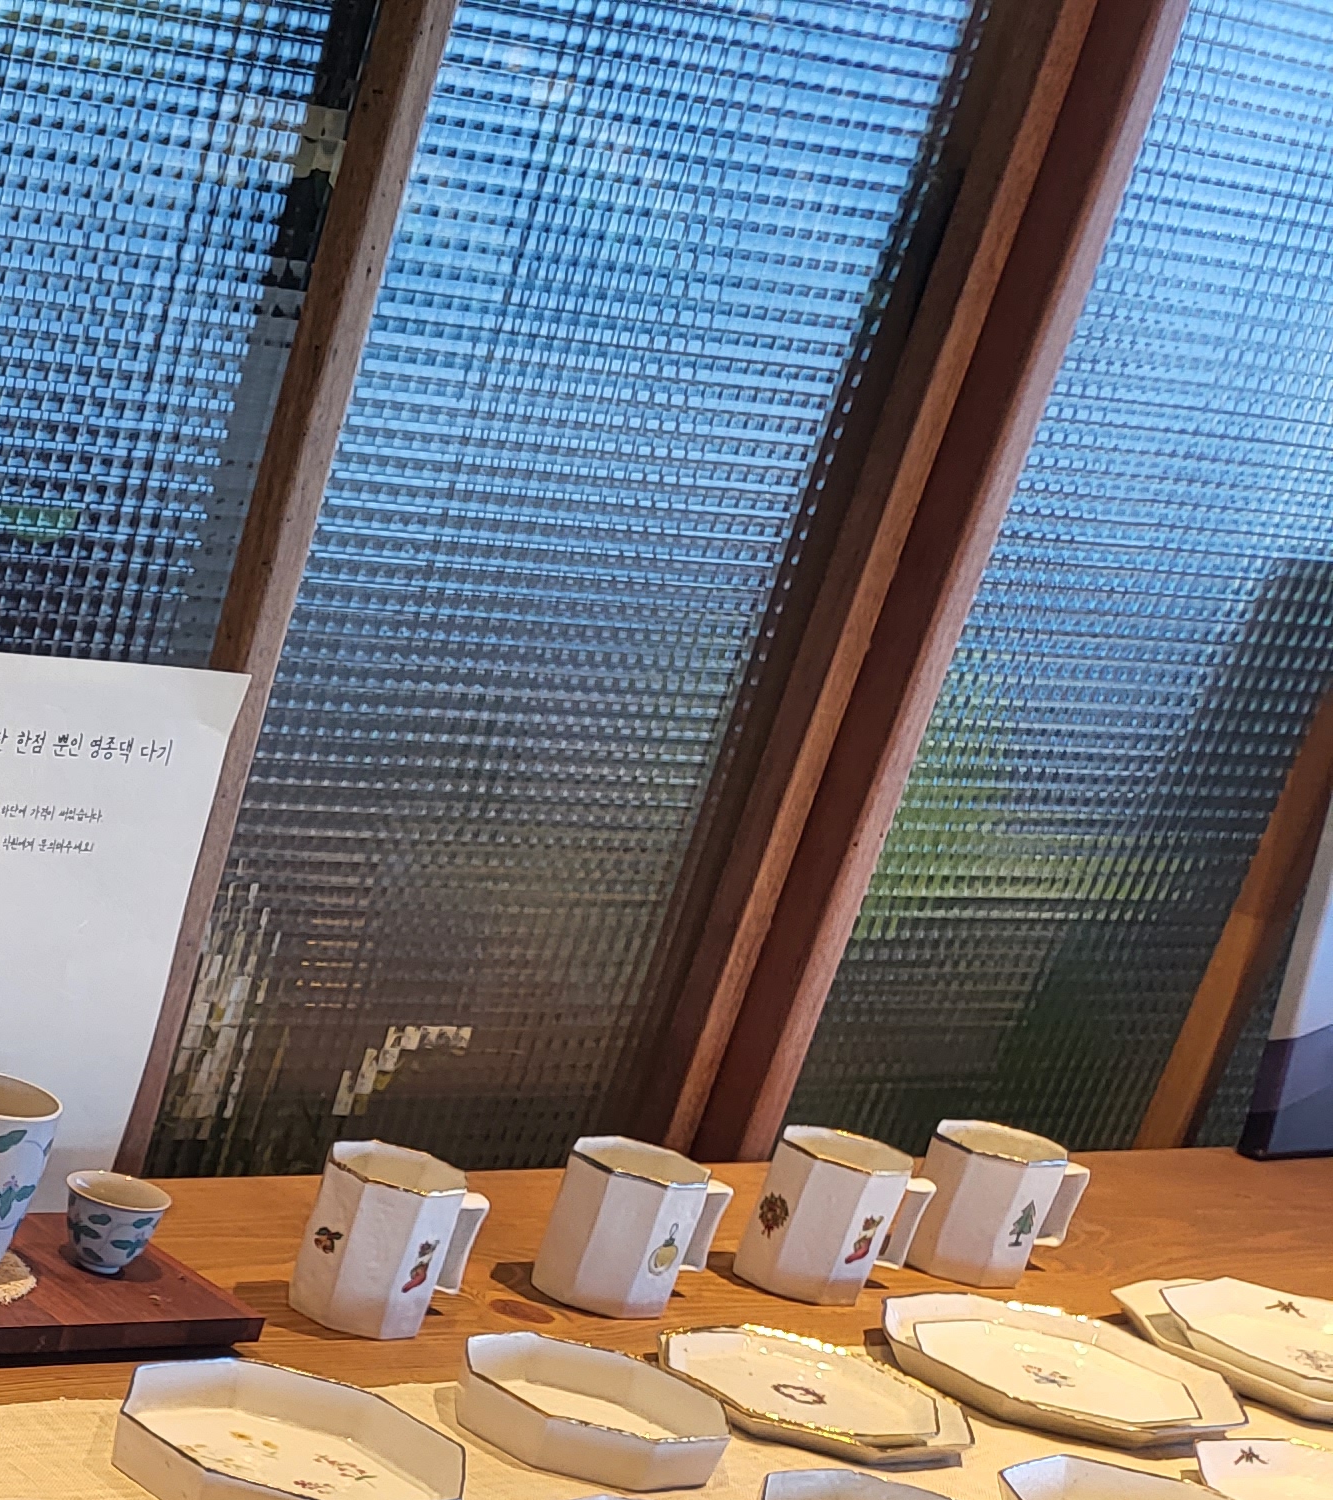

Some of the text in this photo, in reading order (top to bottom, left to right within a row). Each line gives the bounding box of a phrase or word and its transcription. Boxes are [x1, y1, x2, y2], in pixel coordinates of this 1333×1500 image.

[16, 729, 47, 754] 한점
[52, 732, 84, 757] 뿐인
[90, 735, 135, 764] 영종댁
[140, 738, 174, 767] 다기
[1, 803, 28, 819] 하단에
[30, 804, 56, 821] 가격이
[2, 834, 35, 852] 직원에게
